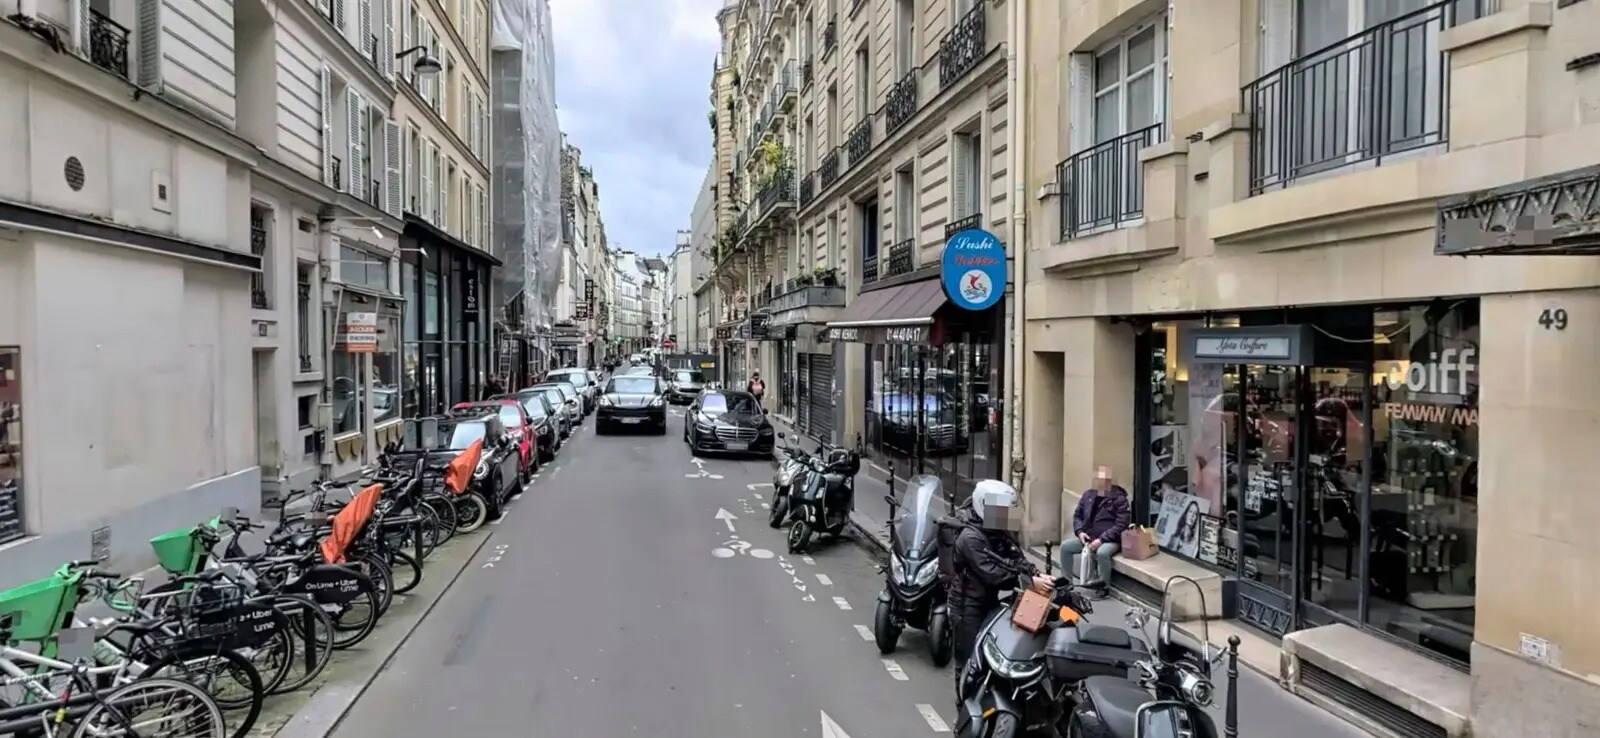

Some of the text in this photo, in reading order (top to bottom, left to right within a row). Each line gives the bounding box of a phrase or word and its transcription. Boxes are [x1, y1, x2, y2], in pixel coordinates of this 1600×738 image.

[955, 236, 994, 250] Sushi
[1538, 308, 1568, 331] 49
[913, 328, 921, 342] 17
[1386, 348, 1476, 395] coiff
[305, 582, 316, 590] On
[316, 581, 334, 589] Lime
[252, 609, 273, 619] Uber
[253, 621, 276, 632] Lime
